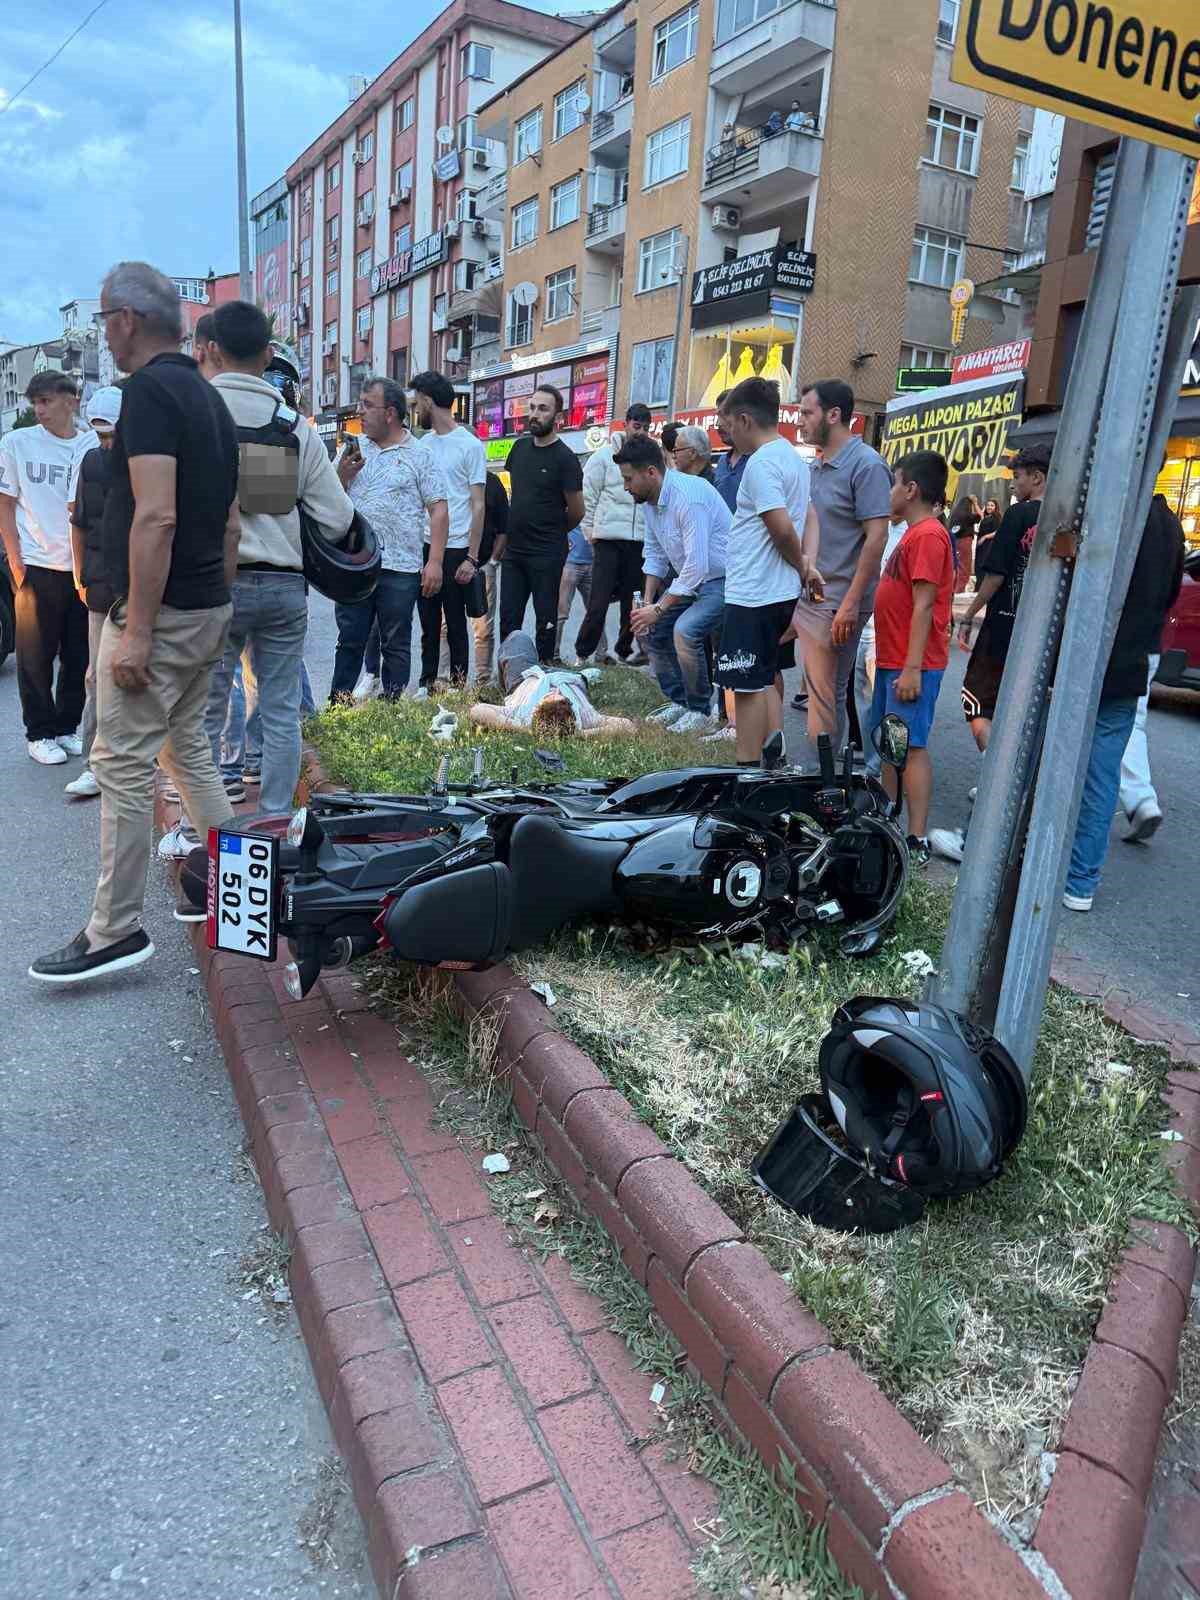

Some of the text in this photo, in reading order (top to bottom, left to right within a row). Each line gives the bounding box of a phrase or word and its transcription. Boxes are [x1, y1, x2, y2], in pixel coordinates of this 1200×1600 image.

[888, 391, 1017, 436] MEGA JAPON PAZARI
[222, 872, 241, 927] 502
